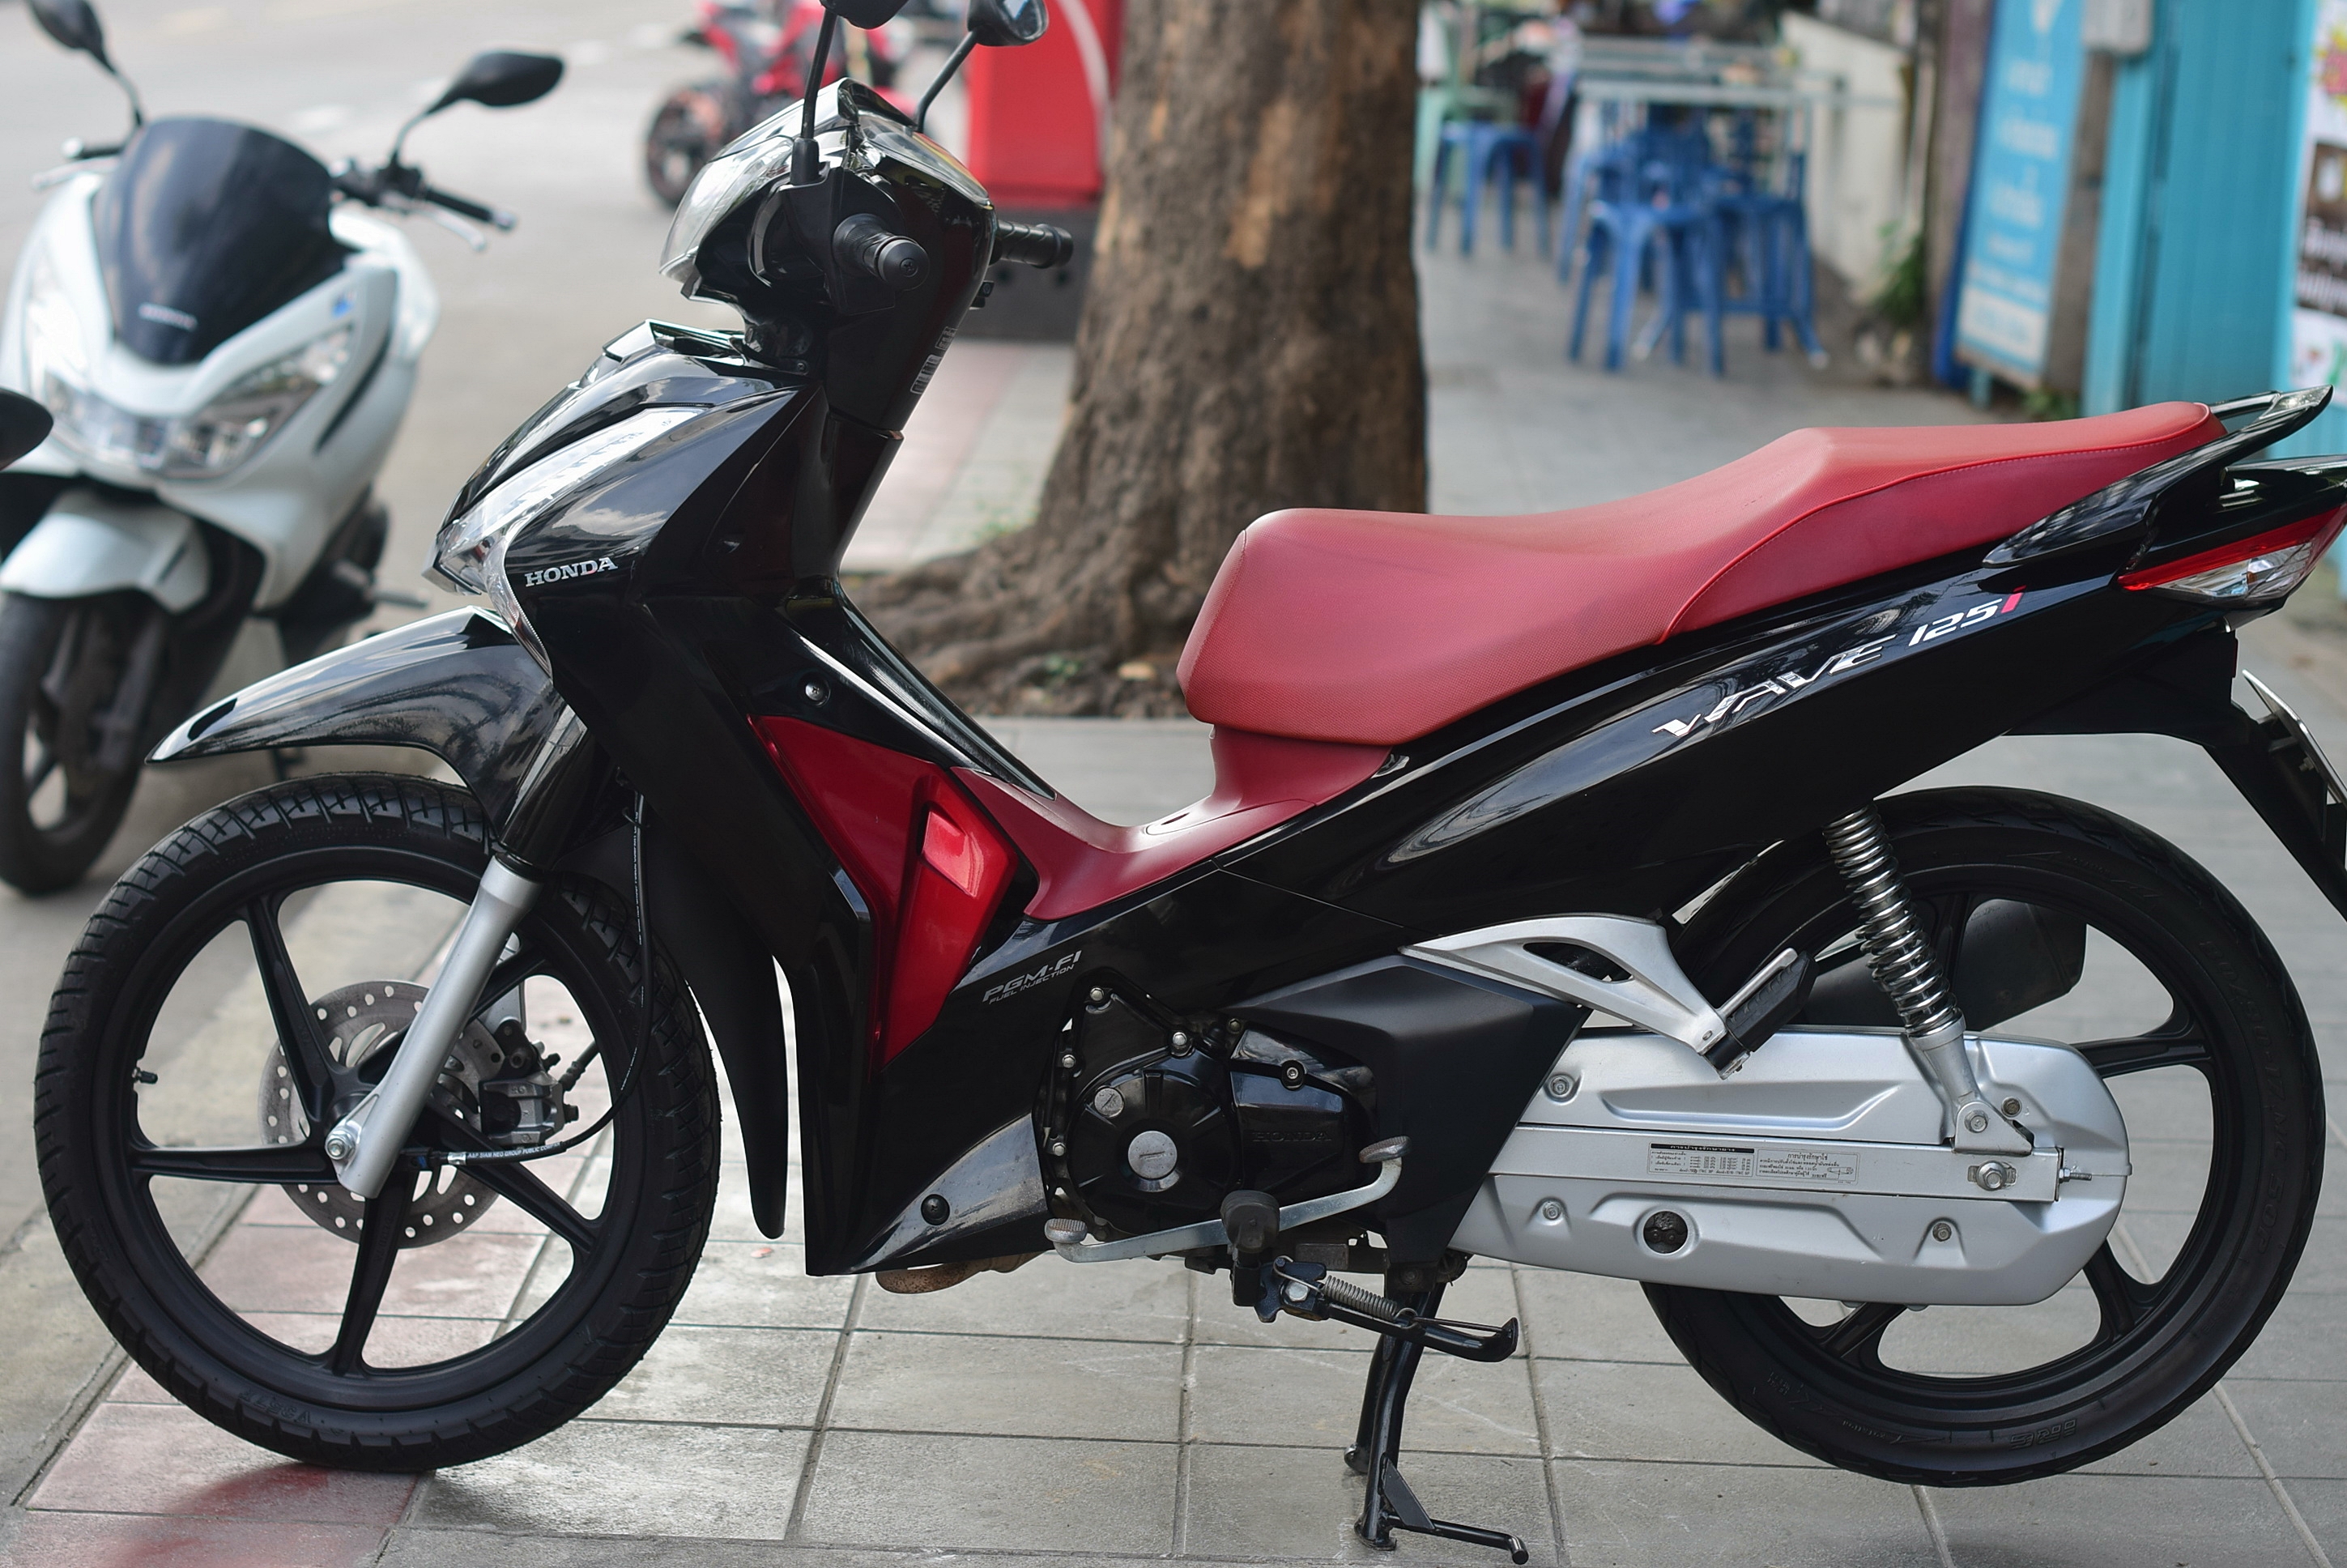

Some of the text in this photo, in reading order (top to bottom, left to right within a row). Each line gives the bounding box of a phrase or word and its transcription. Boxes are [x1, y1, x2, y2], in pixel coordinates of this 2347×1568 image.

[525, 556, 618, 587] HONDA
[1651, 633, 1897, 737] WAVE
[982, 950, 1082, 1003] PGM-FI
[989, 964, 1075, 1005] FUEL INJECTION
[1252, 1131, 1332, 1143] HONDA
